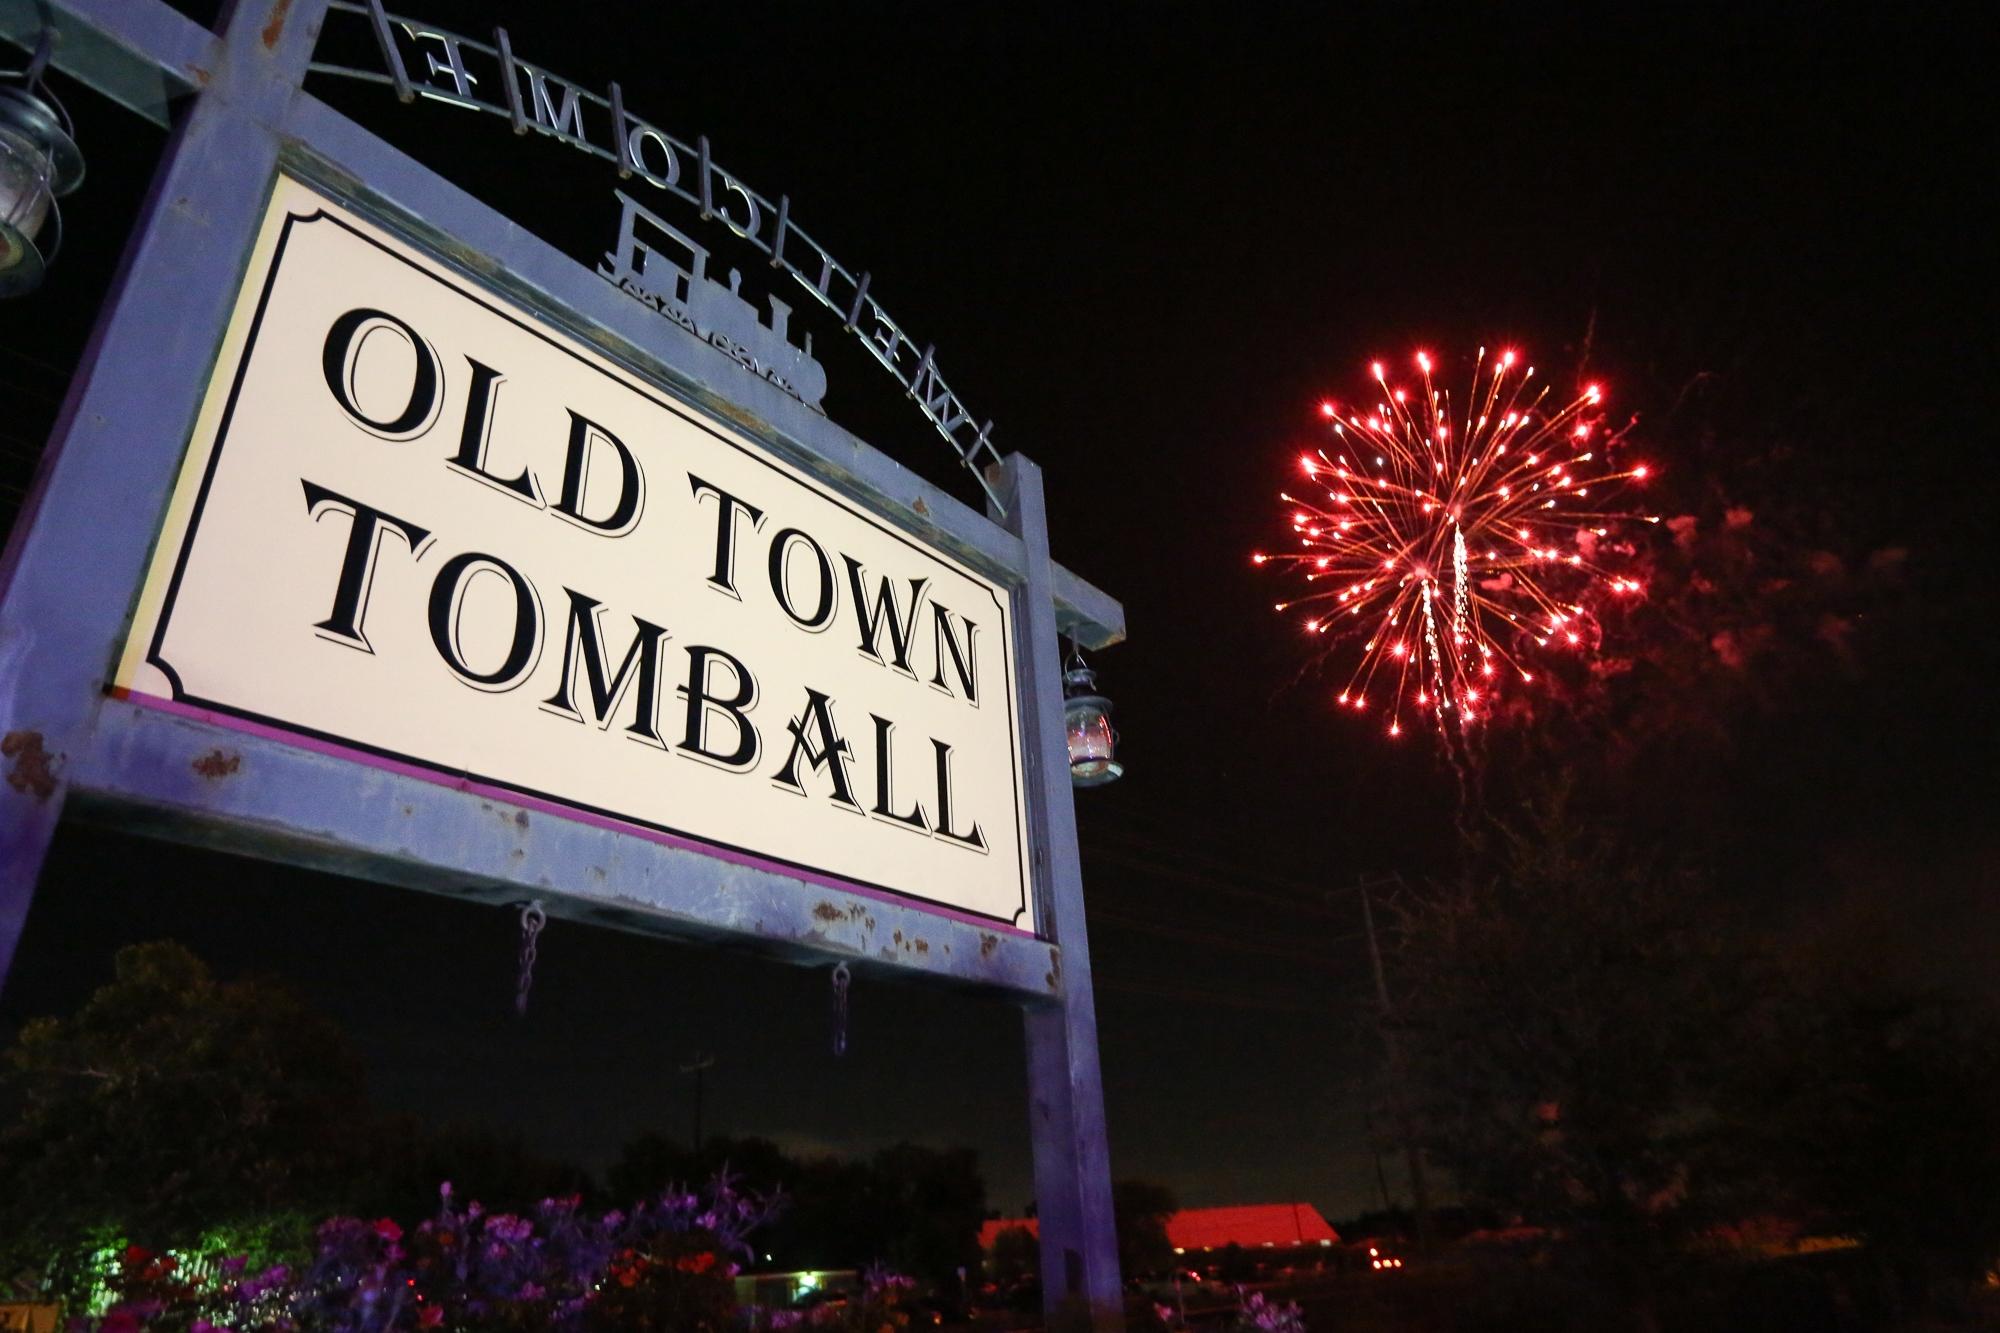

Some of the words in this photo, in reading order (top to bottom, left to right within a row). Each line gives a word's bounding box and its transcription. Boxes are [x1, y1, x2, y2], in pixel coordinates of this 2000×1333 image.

[301, 478, 988, 853] TOMBALL
[323, 308, 645, 538] OLD
[687, 472, 980, 708] TOWN
